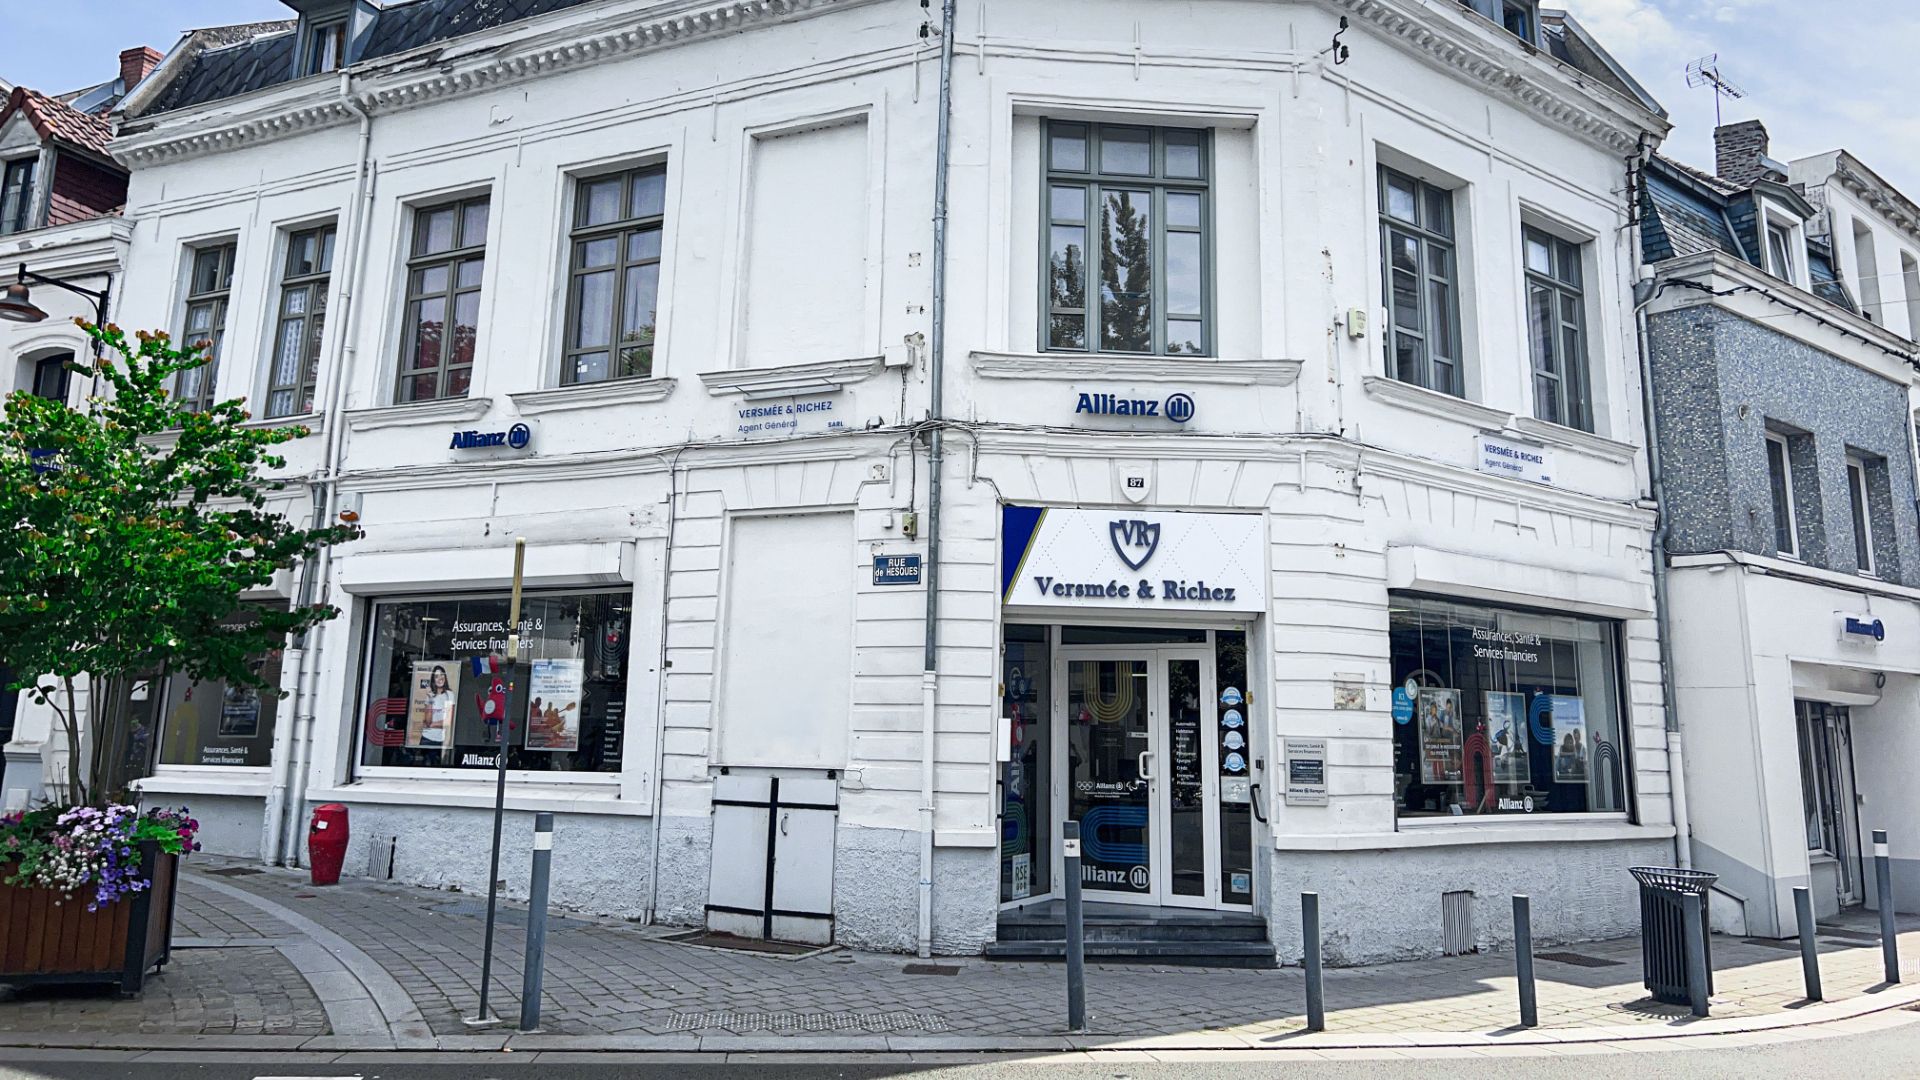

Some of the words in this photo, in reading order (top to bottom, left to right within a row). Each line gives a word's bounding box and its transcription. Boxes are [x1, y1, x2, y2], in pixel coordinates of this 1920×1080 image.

[739, 404, 783, 419] VERSMÉE
[786, 405, 793, 414] &
[796, 401, 832, 413] RICHEZ
[1075, 393, 1159, 416] Allianz
[738, 423, 762, 434] Agent
[765, 419, 798, 430] Général
[449, 430, 506, 449] Allianz
[1484, 443, 1513, 458] VERSMÉE
[1514, 451, 1519, 459] &
[1521, 452, 1543, 464] RICHEZ
[1485, 458, 1501, 468] Agent
[1502, 461, 1523, 472] Général
[1129, 478, 1143, 487] 87
[1118, 520, 1150, 547] VR
[888, 558, 905, 567] RUE
[875, 568, 883, 577] de
[886, 566, 918, 577] HESQUES
[1034, 576, 1130, 598] Versmée
[1136, 579, 1155, 599] &
[1162, 580, 1235, 601] Richez
[452, 620, 505, 633] Assurances,
[506, 618, 533, 631] Snté
[535, 618, 543, 630] &
[450, 637, 487, 650] Services
[1472, 626, 1514, 644] Assurances,
[1515, 632, 1534, 645] Santé
[1535, 634, 1541, 646] &
[1473, 644, 1503, 659] Services
[1504, 646, 1538, 663] financiers
[461, 753, 494, 766] Allianz
[1498, 798, 1523, 810] Allianz
[1015, 864, 1028, 881] RSE
[1081, 864, 1126, 884] llianz
